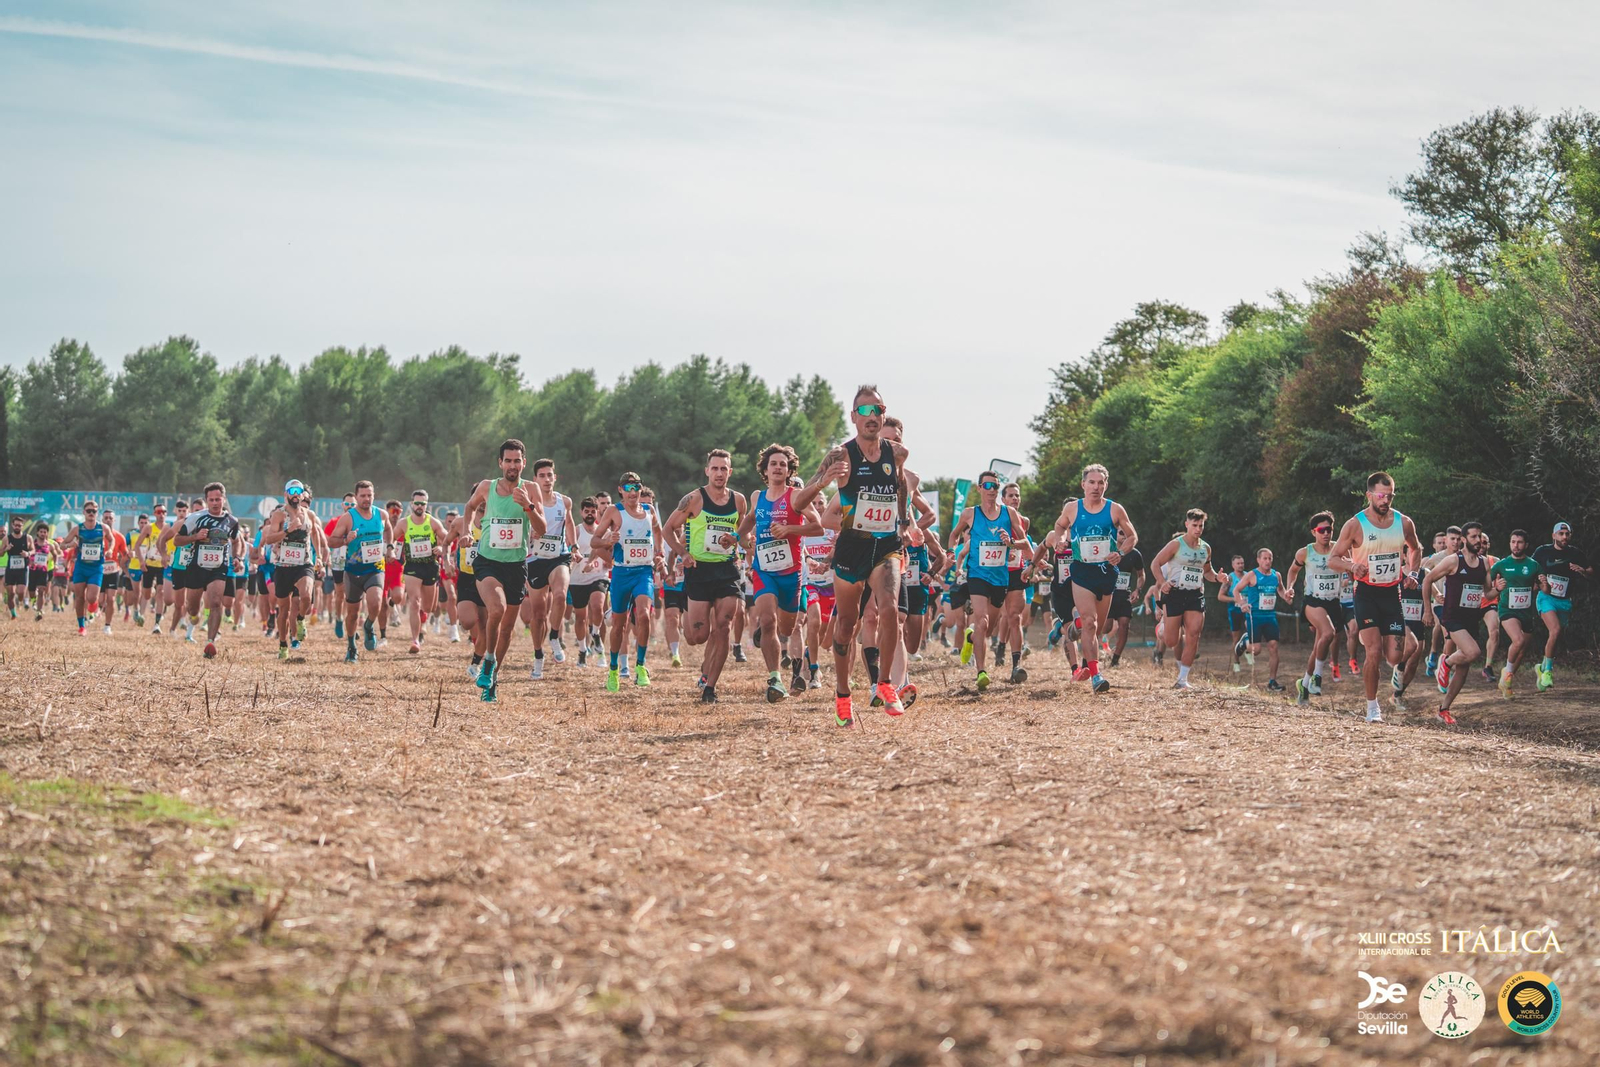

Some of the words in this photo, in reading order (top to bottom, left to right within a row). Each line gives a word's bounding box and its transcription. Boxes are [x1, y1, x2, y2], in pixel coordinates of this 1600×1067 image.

[864, 508, 892, 522] 410
[500, 529, 513, 540] 93
[414, 544, 428, 553] 113
[540, 541, 556, 552] 793
[1092, 545, 1099, 555] 3
[203, 553, 219, 562] 333
[285, 550, 301, 558] 843
[367, 548, 381, 557] 545
[629, 548, 648, 558] 850
[764, 549, 786, 564] 125
[985, 550, 1003, 560] 247
[1375, 563, 1396, 575] 574
[1184, 573, 1199, 583] 844
[1319, 582, 1335, 591] 841
[1514, 595, 1528, 604] 767
